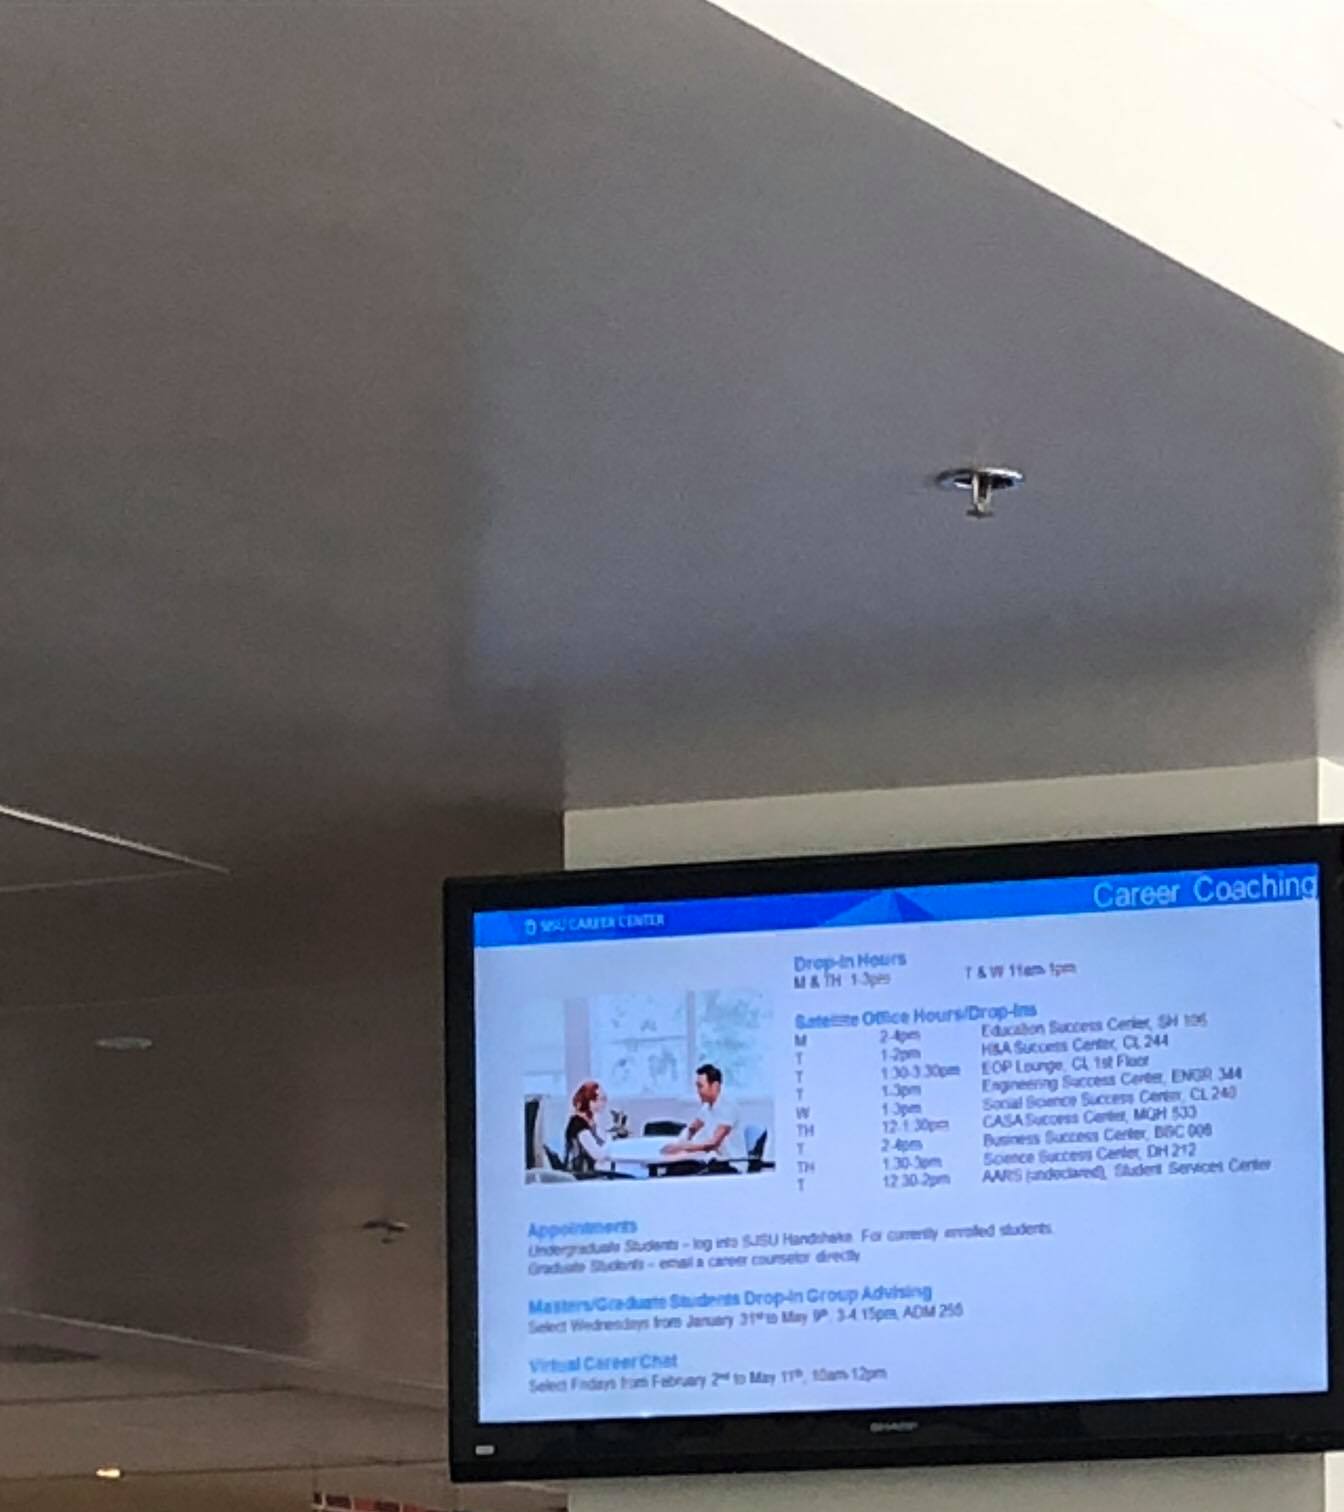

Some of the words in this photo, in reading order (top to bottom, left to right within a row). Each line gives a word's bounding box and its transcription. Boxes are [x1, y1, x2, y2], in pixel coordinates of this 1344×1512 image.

[1094, 877, 1180, 908] Career
[1193, 869, 1317, 906] Coaching
[618, 912, 664, 928] CENTER
[857, 951, 906, 967] Hours
[824, 974, 841, 987] TH
[862, 1008, 909, 1026] Office
[981, 1020, 1045, 1037] Education
[1049, 1017, 1102, 1034] Success
[1013, 1038, 1068, 1054] Success
[1144, 1033, 1168, 1048] 244
[1094, 1055, 1113, 1069] 1st
[1117, 1053, 1149, 1067] Floor
[982, 1076, 1058, 1095] Engineering
[1062, 1073, 1115, 1088] Success
[982, 1095, 1022, 1110] Social
[1026, 1093, 1076, 1108] Science
[1081, 1089, 1133, 1105] Success
[983, 1113, 1023, 1128] CASA
[1025, 1111, 1078, 1126] Success
[797, 1123, 814, 1137] TH
[983, 1131, 1039, 1146] Business
[1045, 1128, 1098, 1143] Success
[984, 1150, 1034, 1165] Science
[1038, 1147, 1092, 1162] Success
[1114, 1161, 1161, 1177] Student
[1168, 1159, 1223, 1174] Services
[1228, 1155, 1271, 1171] Center
[797, 1160, 814, 1174] TH
[528, 1218, 637, 1238] Appointments
[528, 1241, 619, 1259] Undergraduate
[624, 1237, 678, 1252] Students
[693, 1238, 712, 1252] log
[742, 1233, 778, 1247] SJSU
[861, 1228, 881, 1242] For
[887, 1226, 937, 1243] currently
[944, 1223, 994, 1238] enrolled
[528, 1260, 584, 1275] Graduate
[589, 1258, 643, 1272] Students
[659, 1256, 692, 1269] email
[708, 1255, 747, 1267] career
[670, 1291, 739, 1309] Students
[807, 1286, 858, 1305] Group
[862, 1283, 932, 1304] Advising
[528, 1319, 566, 1334] Select
[570, 1317, 648, 1333] Wednesdays
[653, 1315, 681, 1328] from
[686, 1313, 733, 1329] January
[782, 1310, 807, 1325] May
[902, 1304, 935, 1318] ADM
[529, 1356, 579, 1373] Virtual
[583, 1355, 636, 1370] Career
[640, 1353, 677, 1368] Chat
[529, 1378, 567, 1393] Select
[571, 1376, 615, 1392] Fridays
[620, 1375, 648, 1388] from
[652, 1372, 705, 1391] February
[733, 1372, 745, 1384] to
[749, 1370, 775, 1386] May
